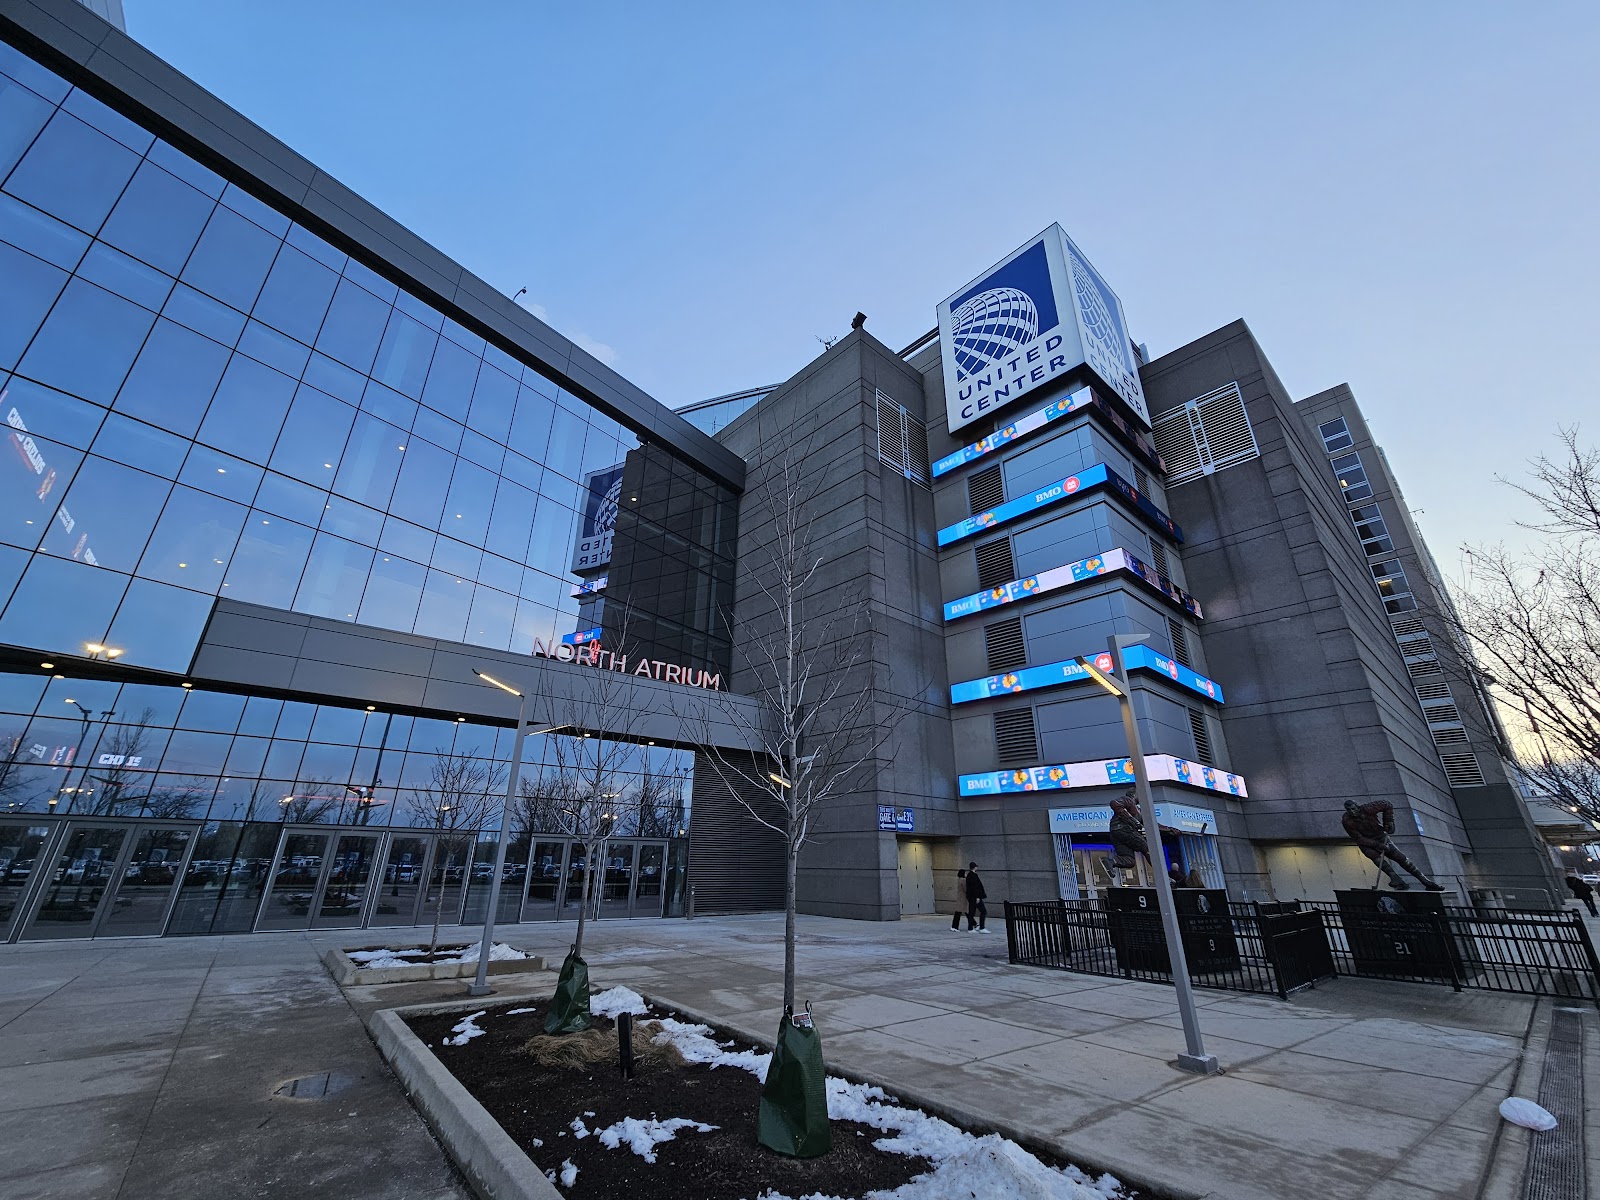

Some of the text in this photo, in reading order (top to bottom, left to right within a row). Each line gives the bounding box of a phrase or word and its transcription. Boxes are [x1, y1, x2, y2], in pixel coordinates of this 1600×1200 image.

[959, 335, 1063, 400] UNITED
[1086, 332, 1139, 396] UNITED
[961, 355, 1066, 419] CENTER
[1090, 353, 1145, 416] CENTER
[938, 456, 959, 471] BMO
[1035, 487, 1062, 503] BMO
[950, 601, 973, 614] BMO
[532, 637, 720, 690] NORTH ATRIUM
[1062, 664, 1083, 677] BM
[1155, 656, 1169, 672] BMO
[967, 779, 991, 790] BMO
[1056, 811, 1108, 821] AMERICAN
[1139, 895, 1147, 908] 9
[1209, 939, 1216, 951] 9
[1394, 941, 1412, 954] 21
